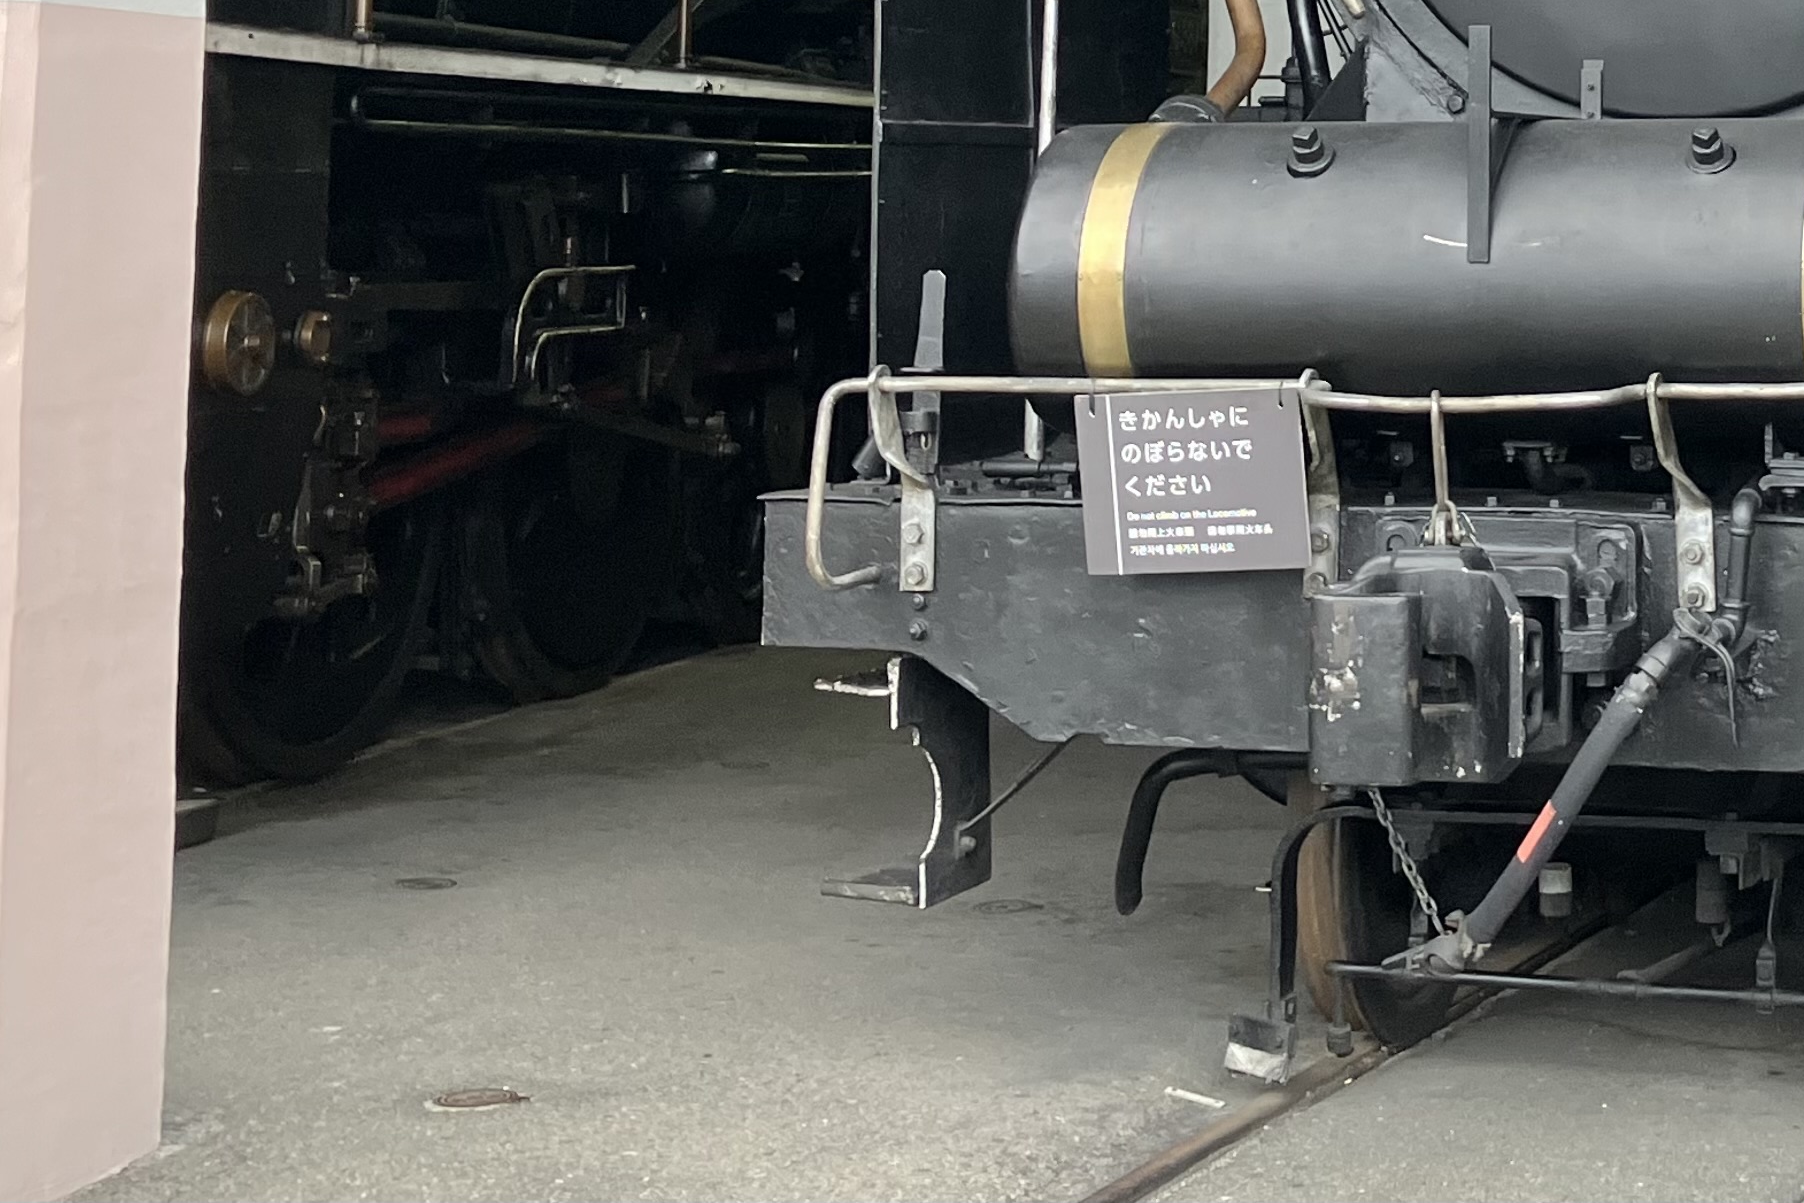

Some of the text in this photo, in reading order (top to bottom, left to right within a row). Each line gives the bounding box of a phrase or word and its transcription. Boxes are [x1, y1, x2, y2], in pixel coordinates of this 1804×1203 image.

[1118, 406, 1249, 431] きかんしゃに
[1121, 439, 1252, 464] のぼらないで
[1125, 474, 1212, 497] ください
[1126, 511, 1140, 521] Do
[1180, 511, 1191, 519] on
[1192, 509, 1207, 518] the
